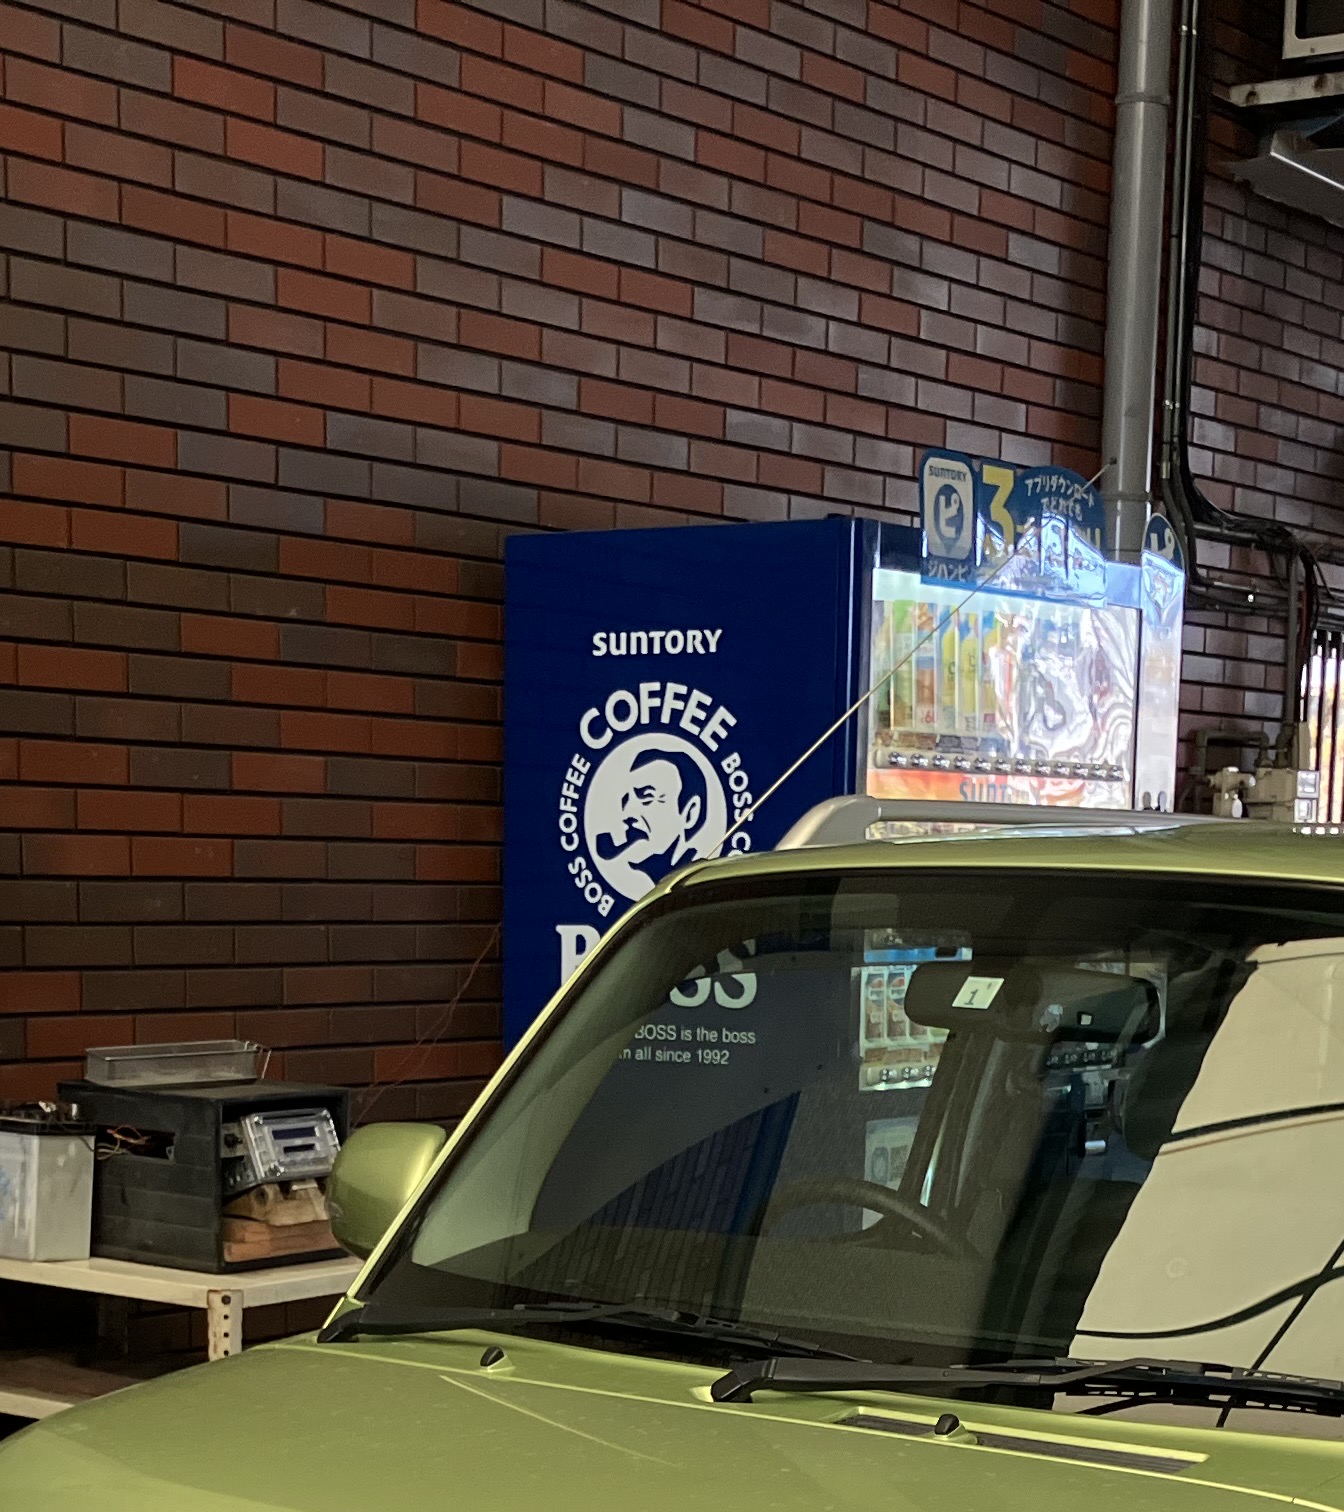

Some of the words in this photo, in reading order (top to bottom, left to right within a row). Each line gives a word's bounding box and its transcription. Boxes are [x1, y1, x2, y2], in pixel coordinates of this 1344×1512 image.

[592, 628, 723, 656] SUNTORY
[579, 681, 738, 752] COFFEE
[558, 753, 592, 852] COFFEE
[720, 752, 754, 822] BOSS
[567, 856, 615, 917] BOSS
[964, 989, 979, 1006] 1
[635, 1047, 652, 1061] all
[655, 1048, 691, 1063] since
[696, 1049, 730, 1065] 1992
[680, 1028, 693, 1042] is
[696, 1027, 718, 1043] the
[722, 1028, 757, 1045] boss
